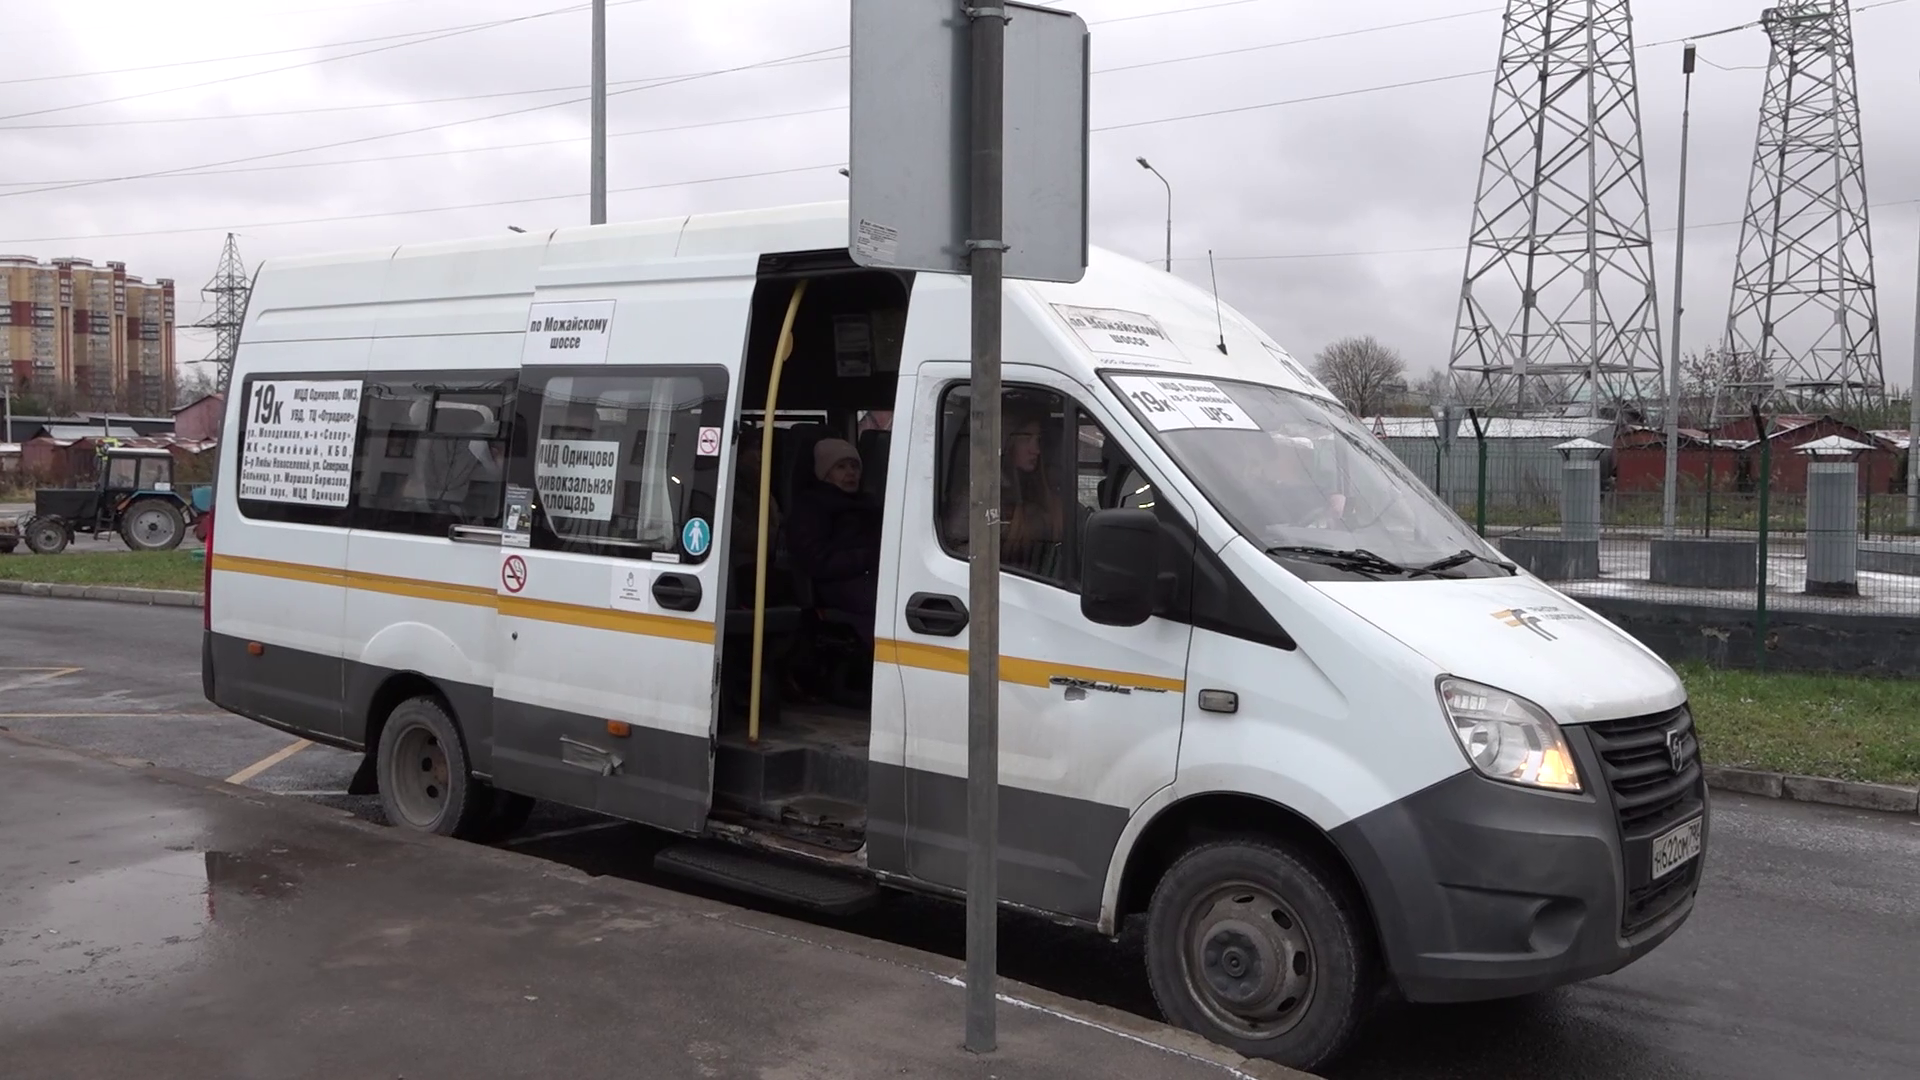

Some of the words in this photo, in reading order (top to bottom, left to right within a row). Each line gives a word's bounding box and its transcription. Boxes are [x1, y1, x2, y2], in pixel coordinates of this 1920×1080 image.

[530, 320, 542, 332] по
[544, 316, 608, 334] Можайскому
[1069, 317, 1086, 327] по
[1083, 316, 1164, 340] Можайскому
[550, 336, 581, 349] шоссе
[1109, 334, 1149, 347] шоссе
[293, 388, 309, 402] МЦД
[309, 409, 317, 423] ТЦ
[1199, 406, 1234, 423] ЦРБ
[246, 442, 258, 453] ЖК
[540, 444, 559, 468] ЦД
[562, 444, 615, 469] Одинцово
[292, 487, 308, 500] МЦД
[543, 493, 595, 514] площадь
